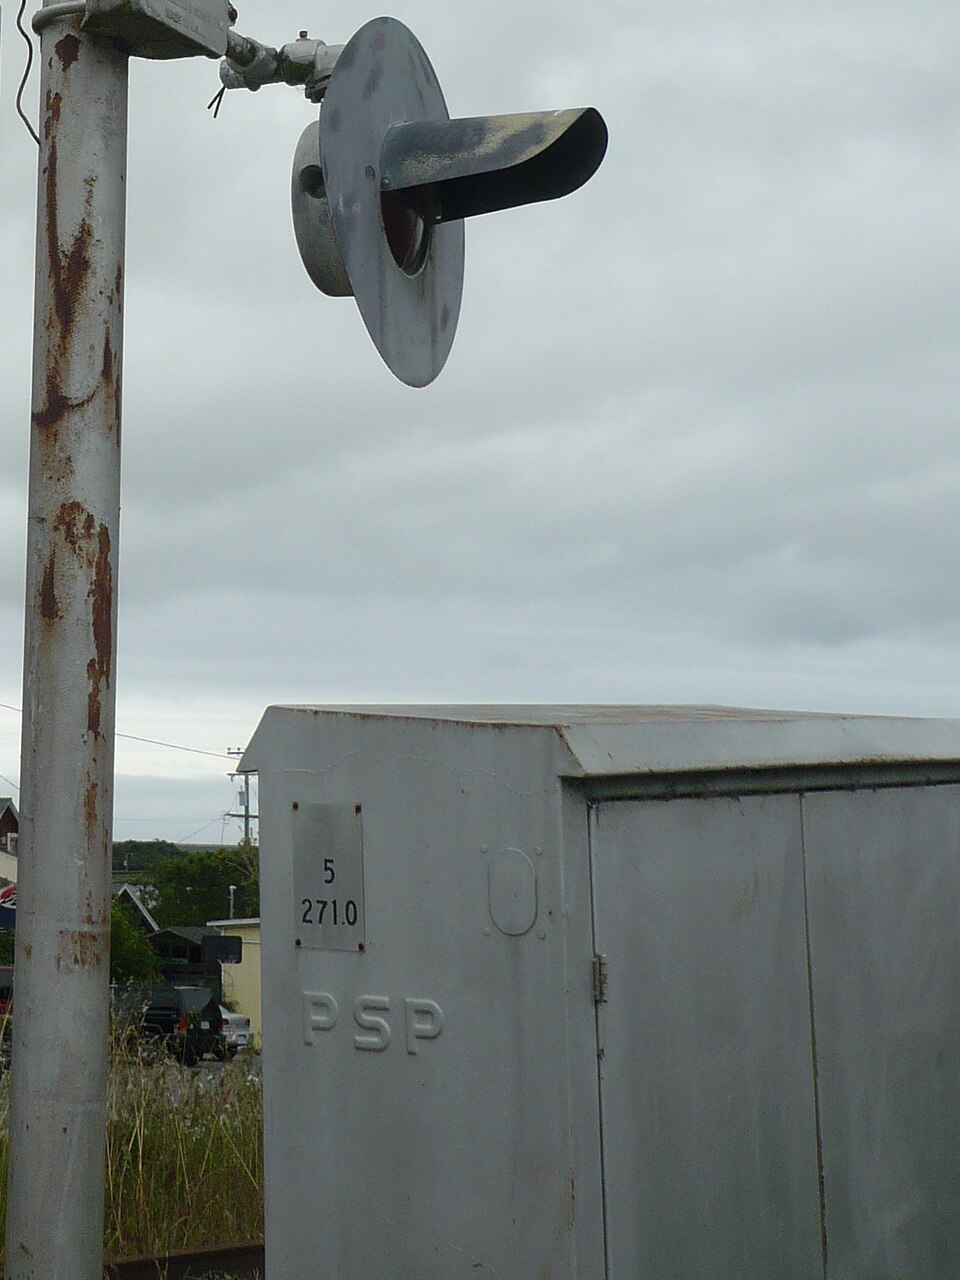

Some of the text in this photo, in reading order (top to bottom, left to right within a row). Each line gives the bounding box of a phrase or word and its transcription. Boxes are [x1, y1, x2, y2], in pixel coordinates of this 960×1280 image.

[323, 858, 336, 884] 5
[301, 898, 358, 926] 271.0
[302, 990, 444, 1056] PSP
